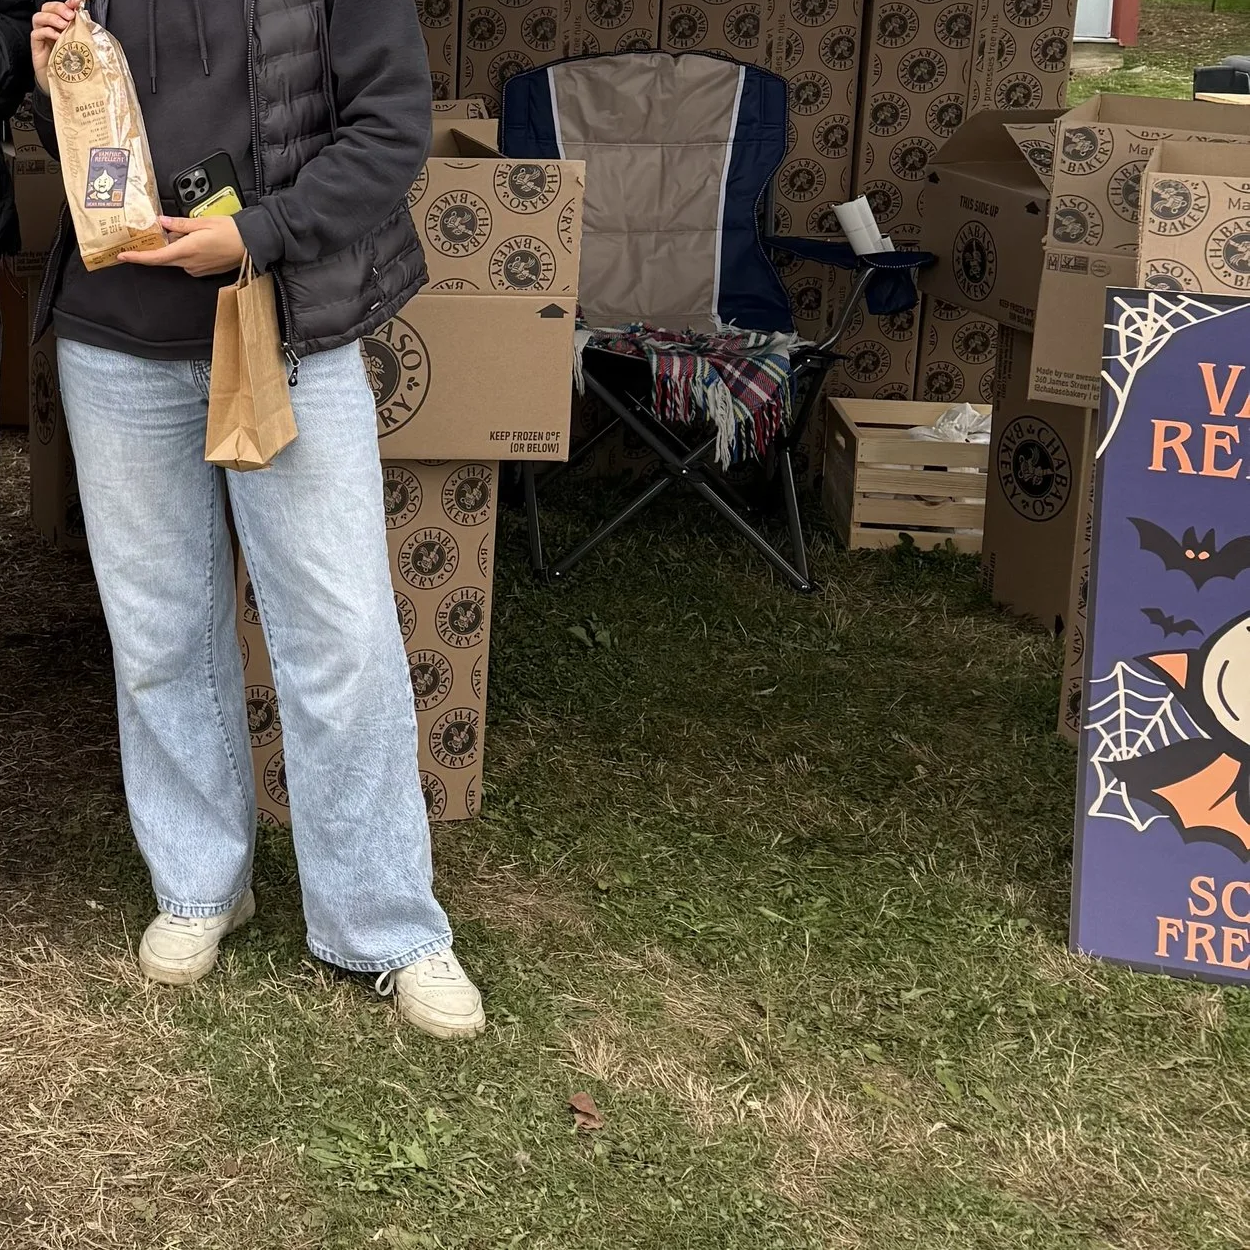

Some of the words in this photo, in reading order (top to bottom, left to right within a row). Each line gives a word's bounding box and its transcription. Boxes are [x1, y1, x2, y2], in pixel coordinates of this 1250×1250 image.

[55, 43, 90, 66] CHABASO
[59, 68, 93, 82] BAKERY
[1067, 137, 1111, 173] BAKERY
[1111, 163, 1148, 207] CHABA
[428, 192, 468, 232] BAKERY
[960, 195, 973, 211] THIS
[974, 199, 989, 215] SIDE
[989, 205, 999, 218] UP
[1157, 192, 1207, 234] BAKERY
[441, 204, 489, 254] CHABASO
[956, 224, 995, 264] CHABASO
[492, 238, 532, 277] BAKERY
[956, 268, 991, 298] BAKERY
[1075, 375, 1100, 383] awesom
[489, 431, 511, 441] KEEP
[512, 431, 544, 441] FROZEN
[510, 442, 524, 454] (OR
[526, 443, 560, 454] BELOW)
[1000, 421, 1025, 502] BAKERY
[1032, 427, 1068, 517] CHABASO
[386, 468, 419, 512] HABASO
[444, 488, 479, 523] BAKERY
[401, 551, 436, 587] BAKERY
[414, 530, 456, 573] CHABASO
[438, 611, 472, 646] BAKERY
[431, 732, 466, 767] BAKERY
